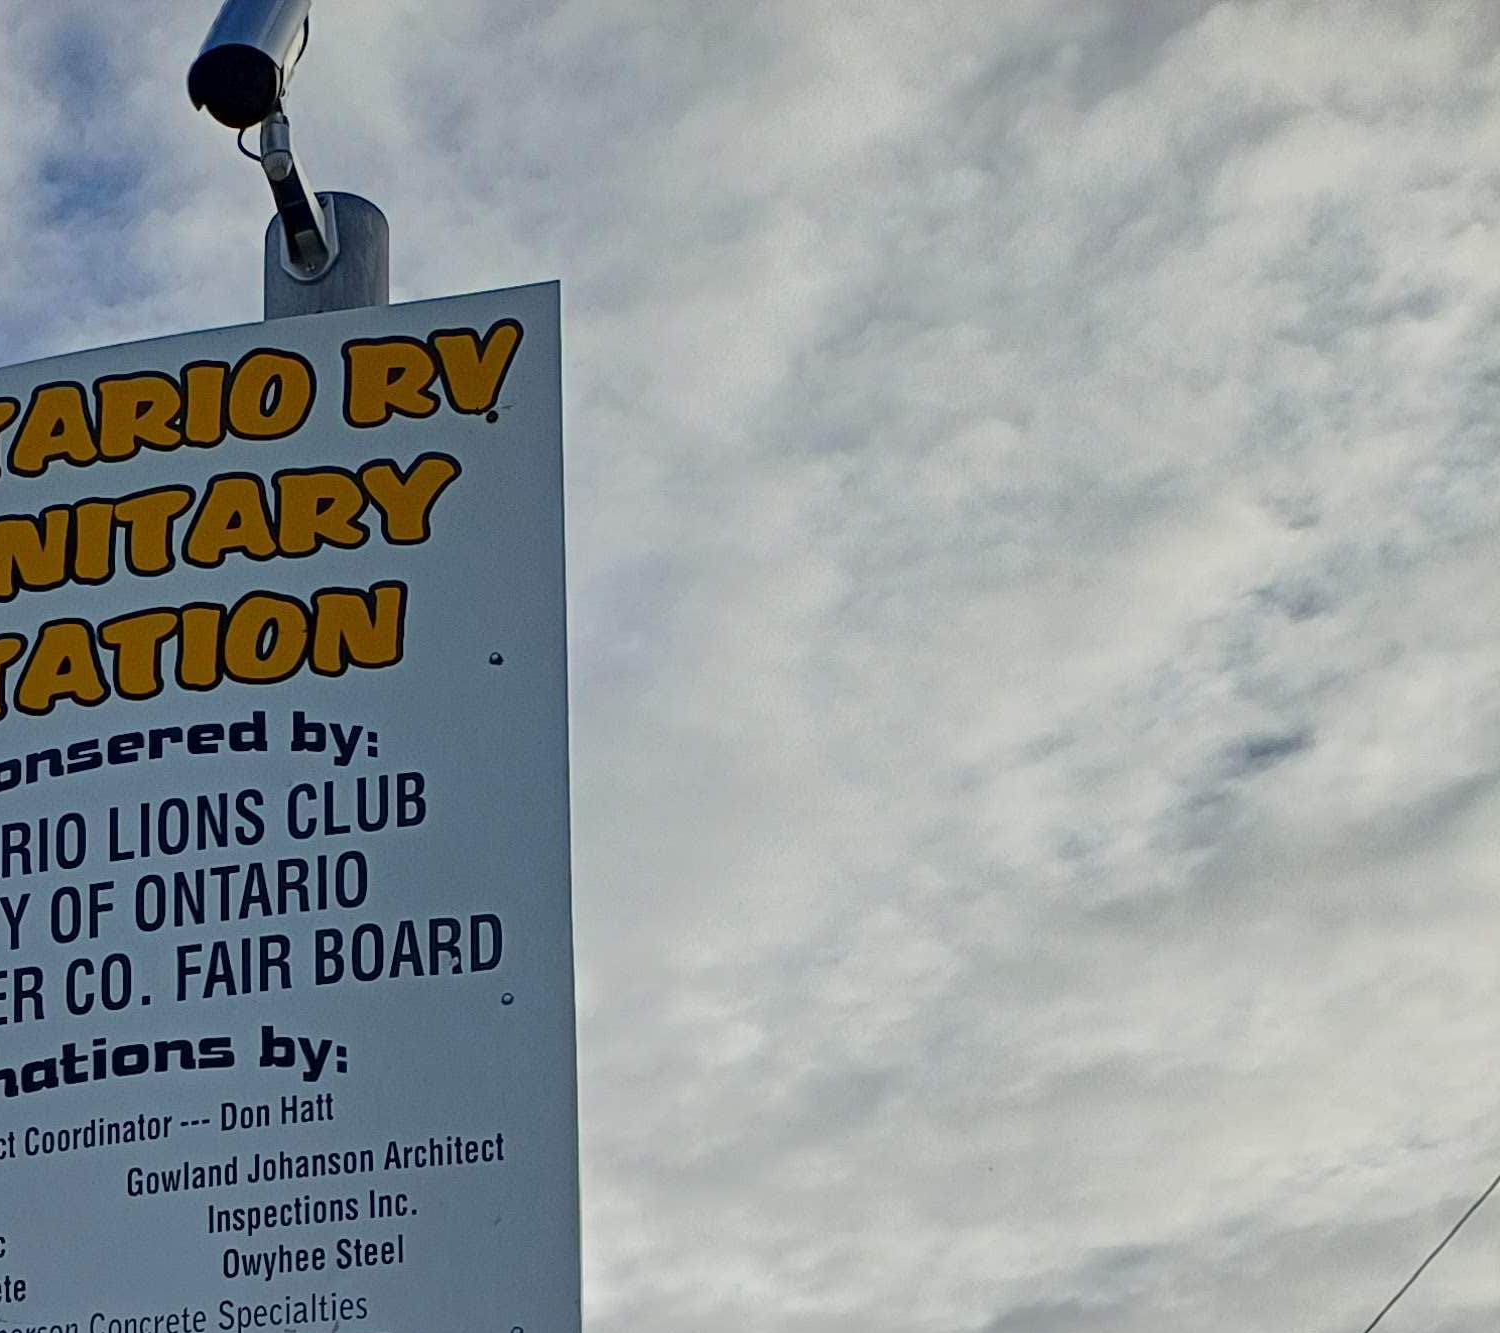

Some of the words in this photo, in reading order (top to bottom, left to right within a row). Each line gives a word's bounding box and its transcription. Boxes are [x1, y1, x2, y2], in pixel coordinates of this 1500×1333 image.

[342, 319, 523, 428] RV
[292, 712, 380, 766] by:
[109, 788, 265, 862] LIONS
[288, 772, 427, 837] CLUB
[50, 882, 114, 939] OF
[136, 851, 368, 932] ONTARIO
[65, 953, 150, 1015] CO.
[177, 934, 292, 1001] FAIR
[317, 913, 501, 985] BOARD
[260, 1026, 348, 1082] by:
[25, 1114, 173, 1156] Coordinator
[221, 1102, 270, 1131] Don
[281, 1094, 334, 1124] Hatt
[128, 1157, 238, 1197] Gowland
[248, 1148, 374, 1184] Johanson
[384, 1134, 505, 1171] Architect
[209, 1198, 358, 1236] Inspections
[369, 1190, 418, 1219] Inc.
[223, 1245, 325, 1281] Owyhee
[336, 1235, 404, 1270] Steel
[218, 1293, 368, 1333] Specialties
